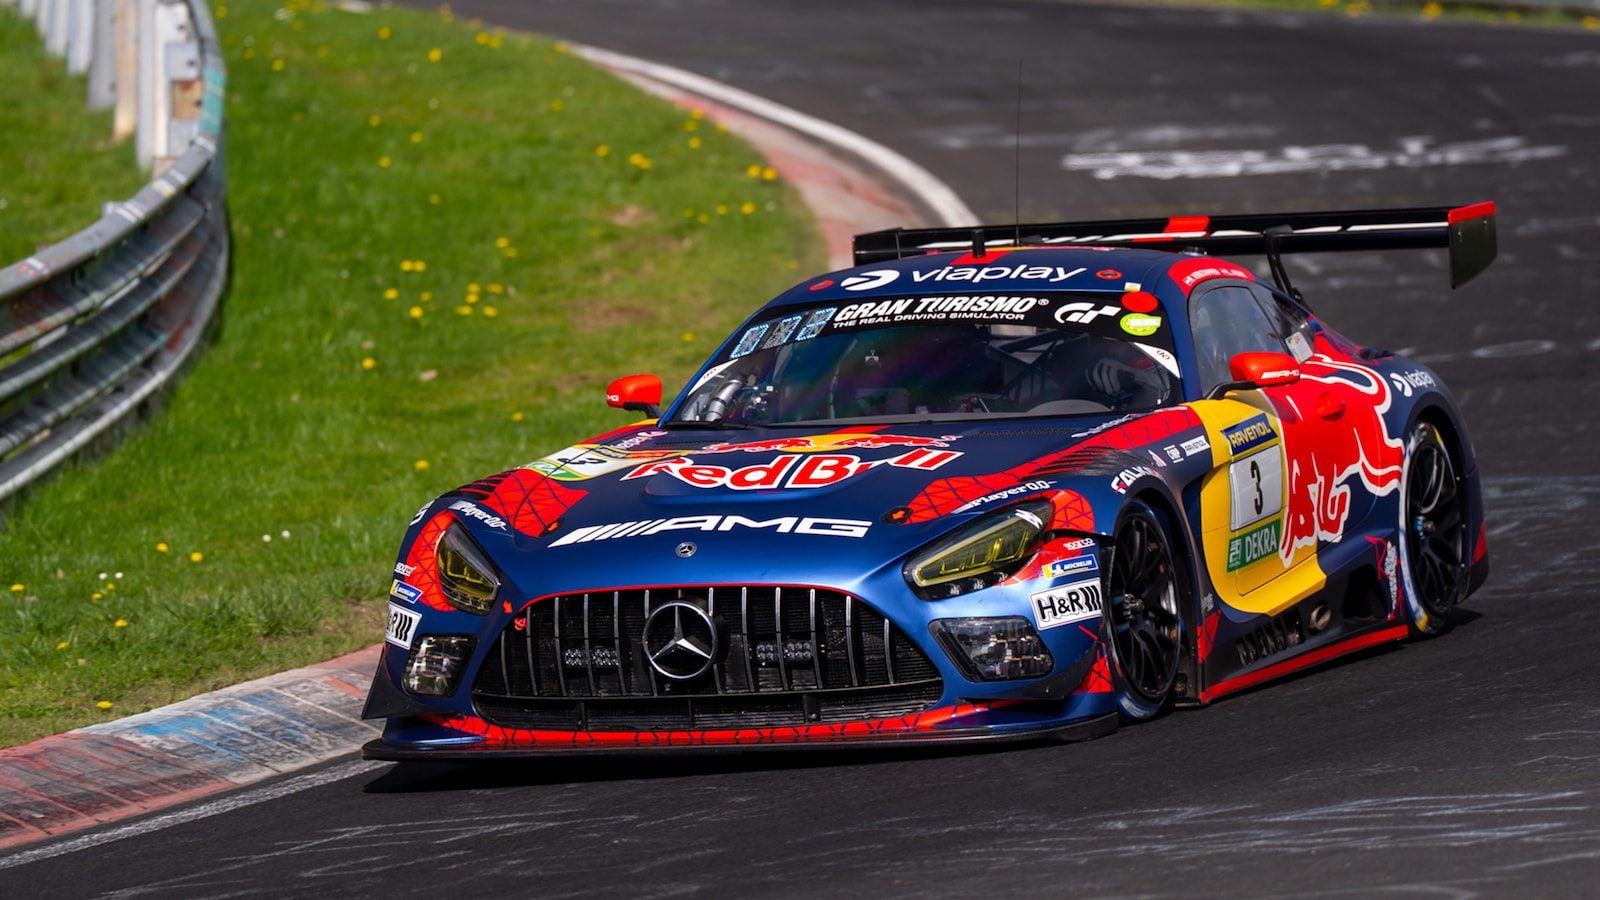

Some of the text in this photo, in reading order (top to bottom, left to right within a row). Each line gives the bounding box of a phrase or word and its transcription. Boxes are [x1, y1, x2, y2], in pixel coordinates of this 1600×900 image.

[911, 264, 1088, 284] viaplay
[832, 312, 1025, 329] THE REAL DRIVING SIMULATOR
[833, 298, 914, 322] GRAN
[1403, 369, 1437, 389] viaplay
[1230, 421, 1272, 448] RAVENOL
[1250, 459, 1264, 516] 3
[640, 515, 872, 538] AMG
[1245, 524, 1278, 563] DEKRA
[1037, 590, 1084, 620] H&R
